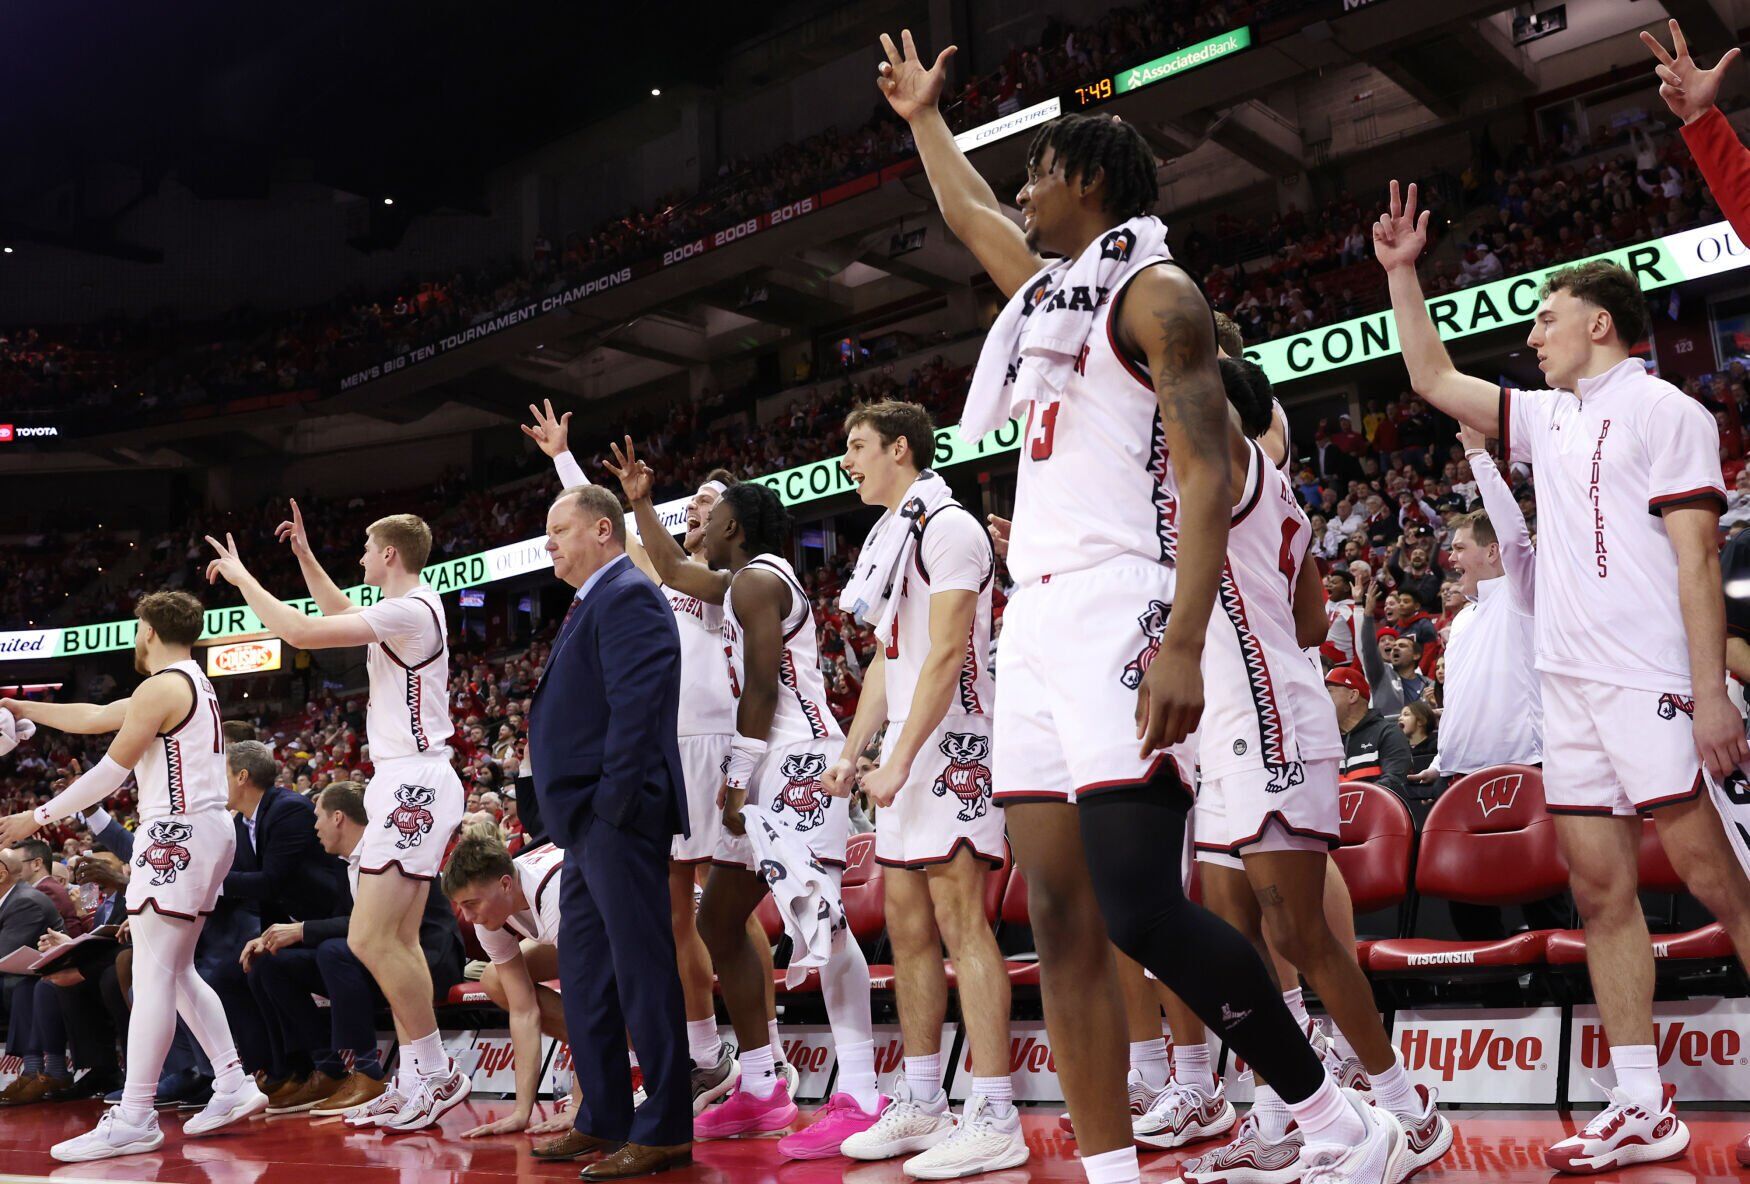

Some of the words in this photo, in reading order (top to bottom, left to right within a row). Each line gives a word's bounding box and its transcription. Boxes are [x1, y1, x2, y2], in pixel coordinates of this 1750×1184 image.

[1141, 37, 1238, 82] AssociatedBank
[1075, 78, 1112, 105] 7:49
[663, 240, 705, 266] 2004
[714, 219, 758, 247] 2008
[770, 198, 814, 225] 2015
[340, 364, 381, 391] MEN'S
[384, 355, 406, 373] BIG
[410, 344, 435, 364] TEN
[439, 304, 538, 352] TOURNAMENT
[541, 267, 632, 313] CHAMPIONS
[16, 427, 57, 436] TOYOTA
[1590, 419, 1611, 578] BADGERS
[63, 619, 140, 653] BUIL
[219, 647, 271, 669] COUSINS
[1407, 951, 1475, 965] WISCONSIN
[1401, 1029, 1543, 1082] HyVee
